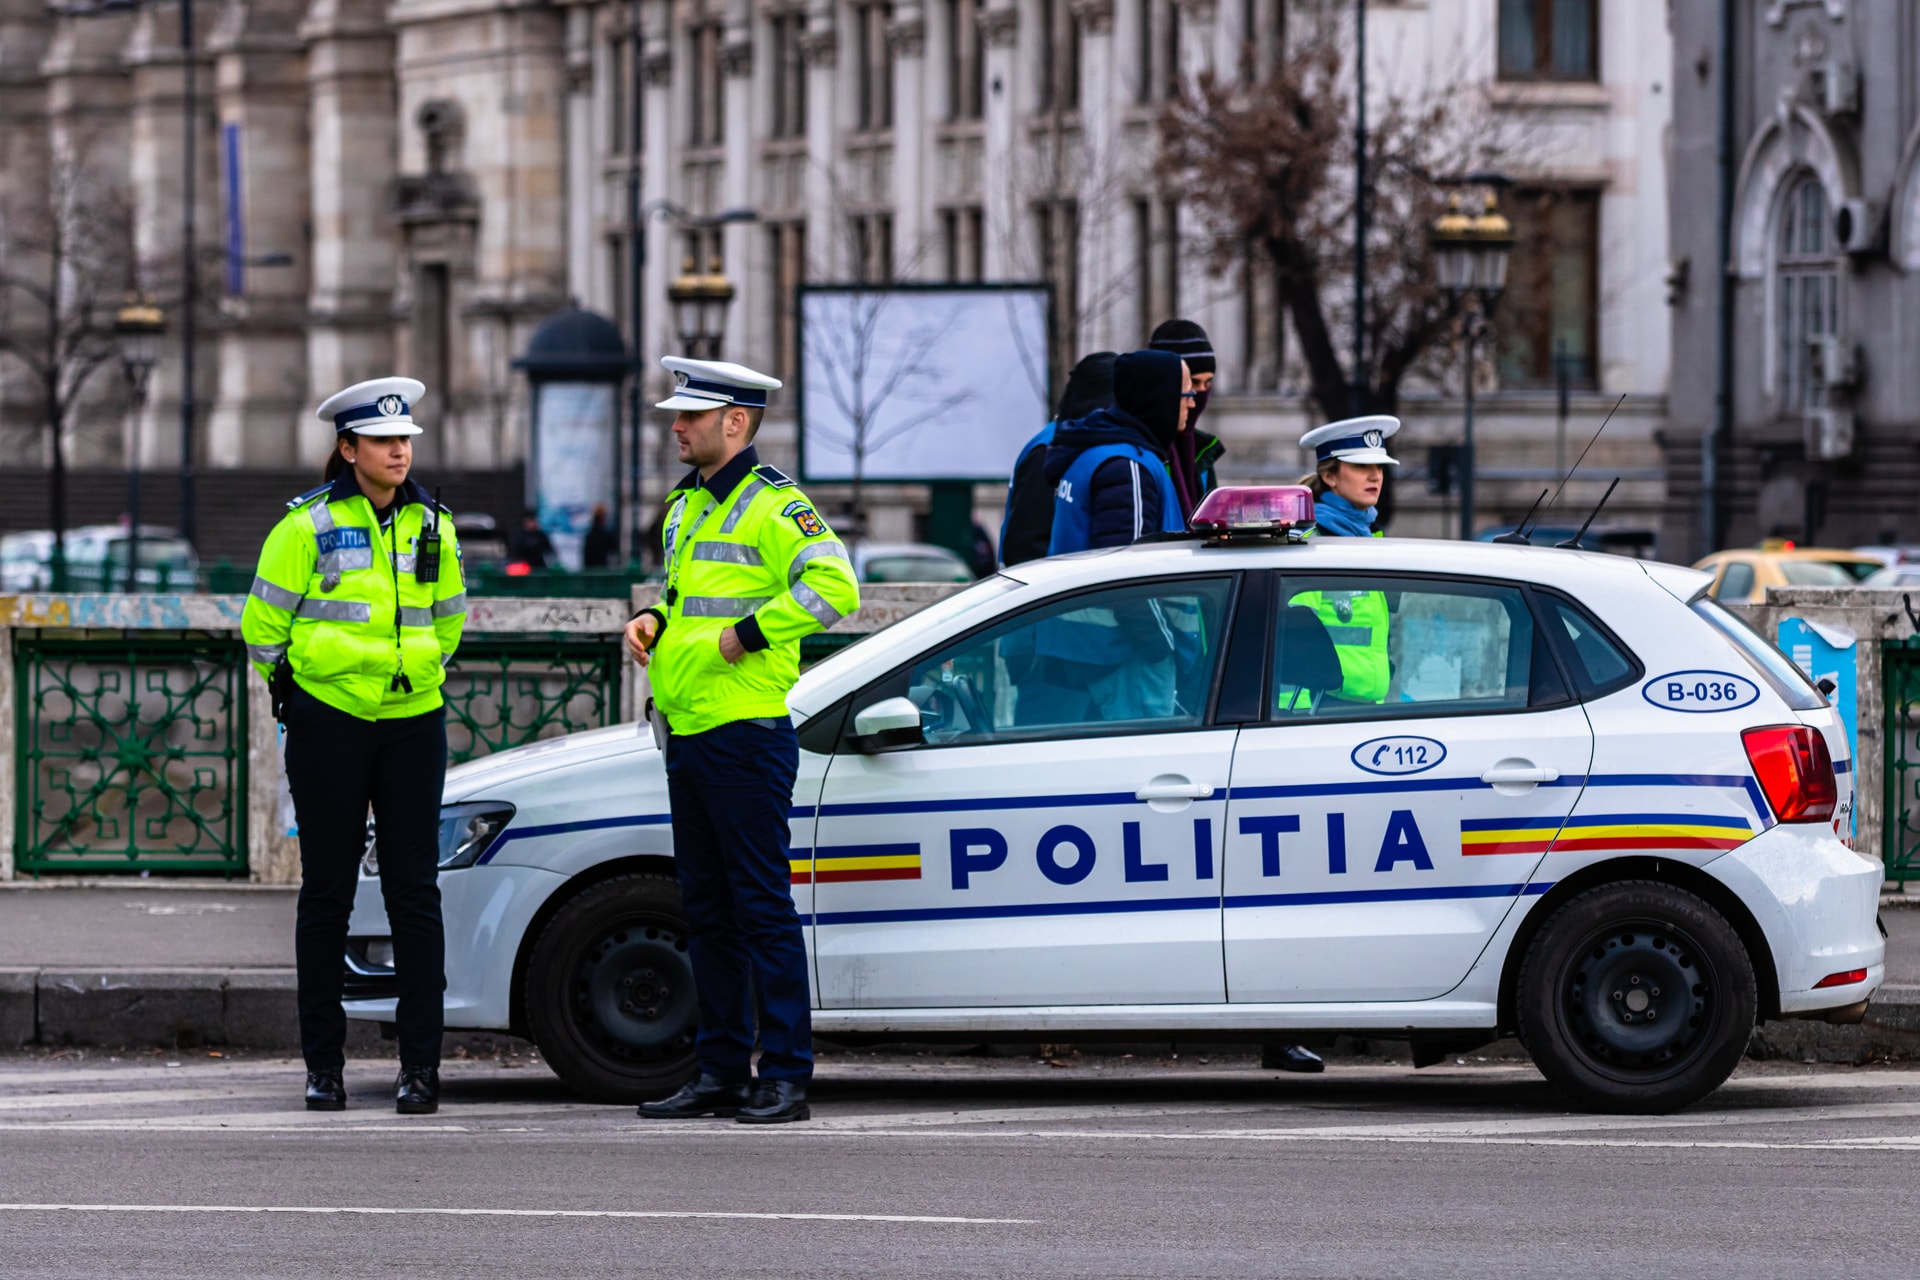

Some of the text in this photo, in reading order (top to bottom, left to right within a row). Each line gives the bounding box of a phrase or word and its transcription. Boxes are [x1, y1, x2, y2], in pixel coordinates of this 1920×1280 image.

[320, 531, 367, 551] POLITIA
[1667, 682, 1738, 702] B-036
[1395, 744, 1428, 765] 112
[949, 809, 1435, 890] POLITIA
